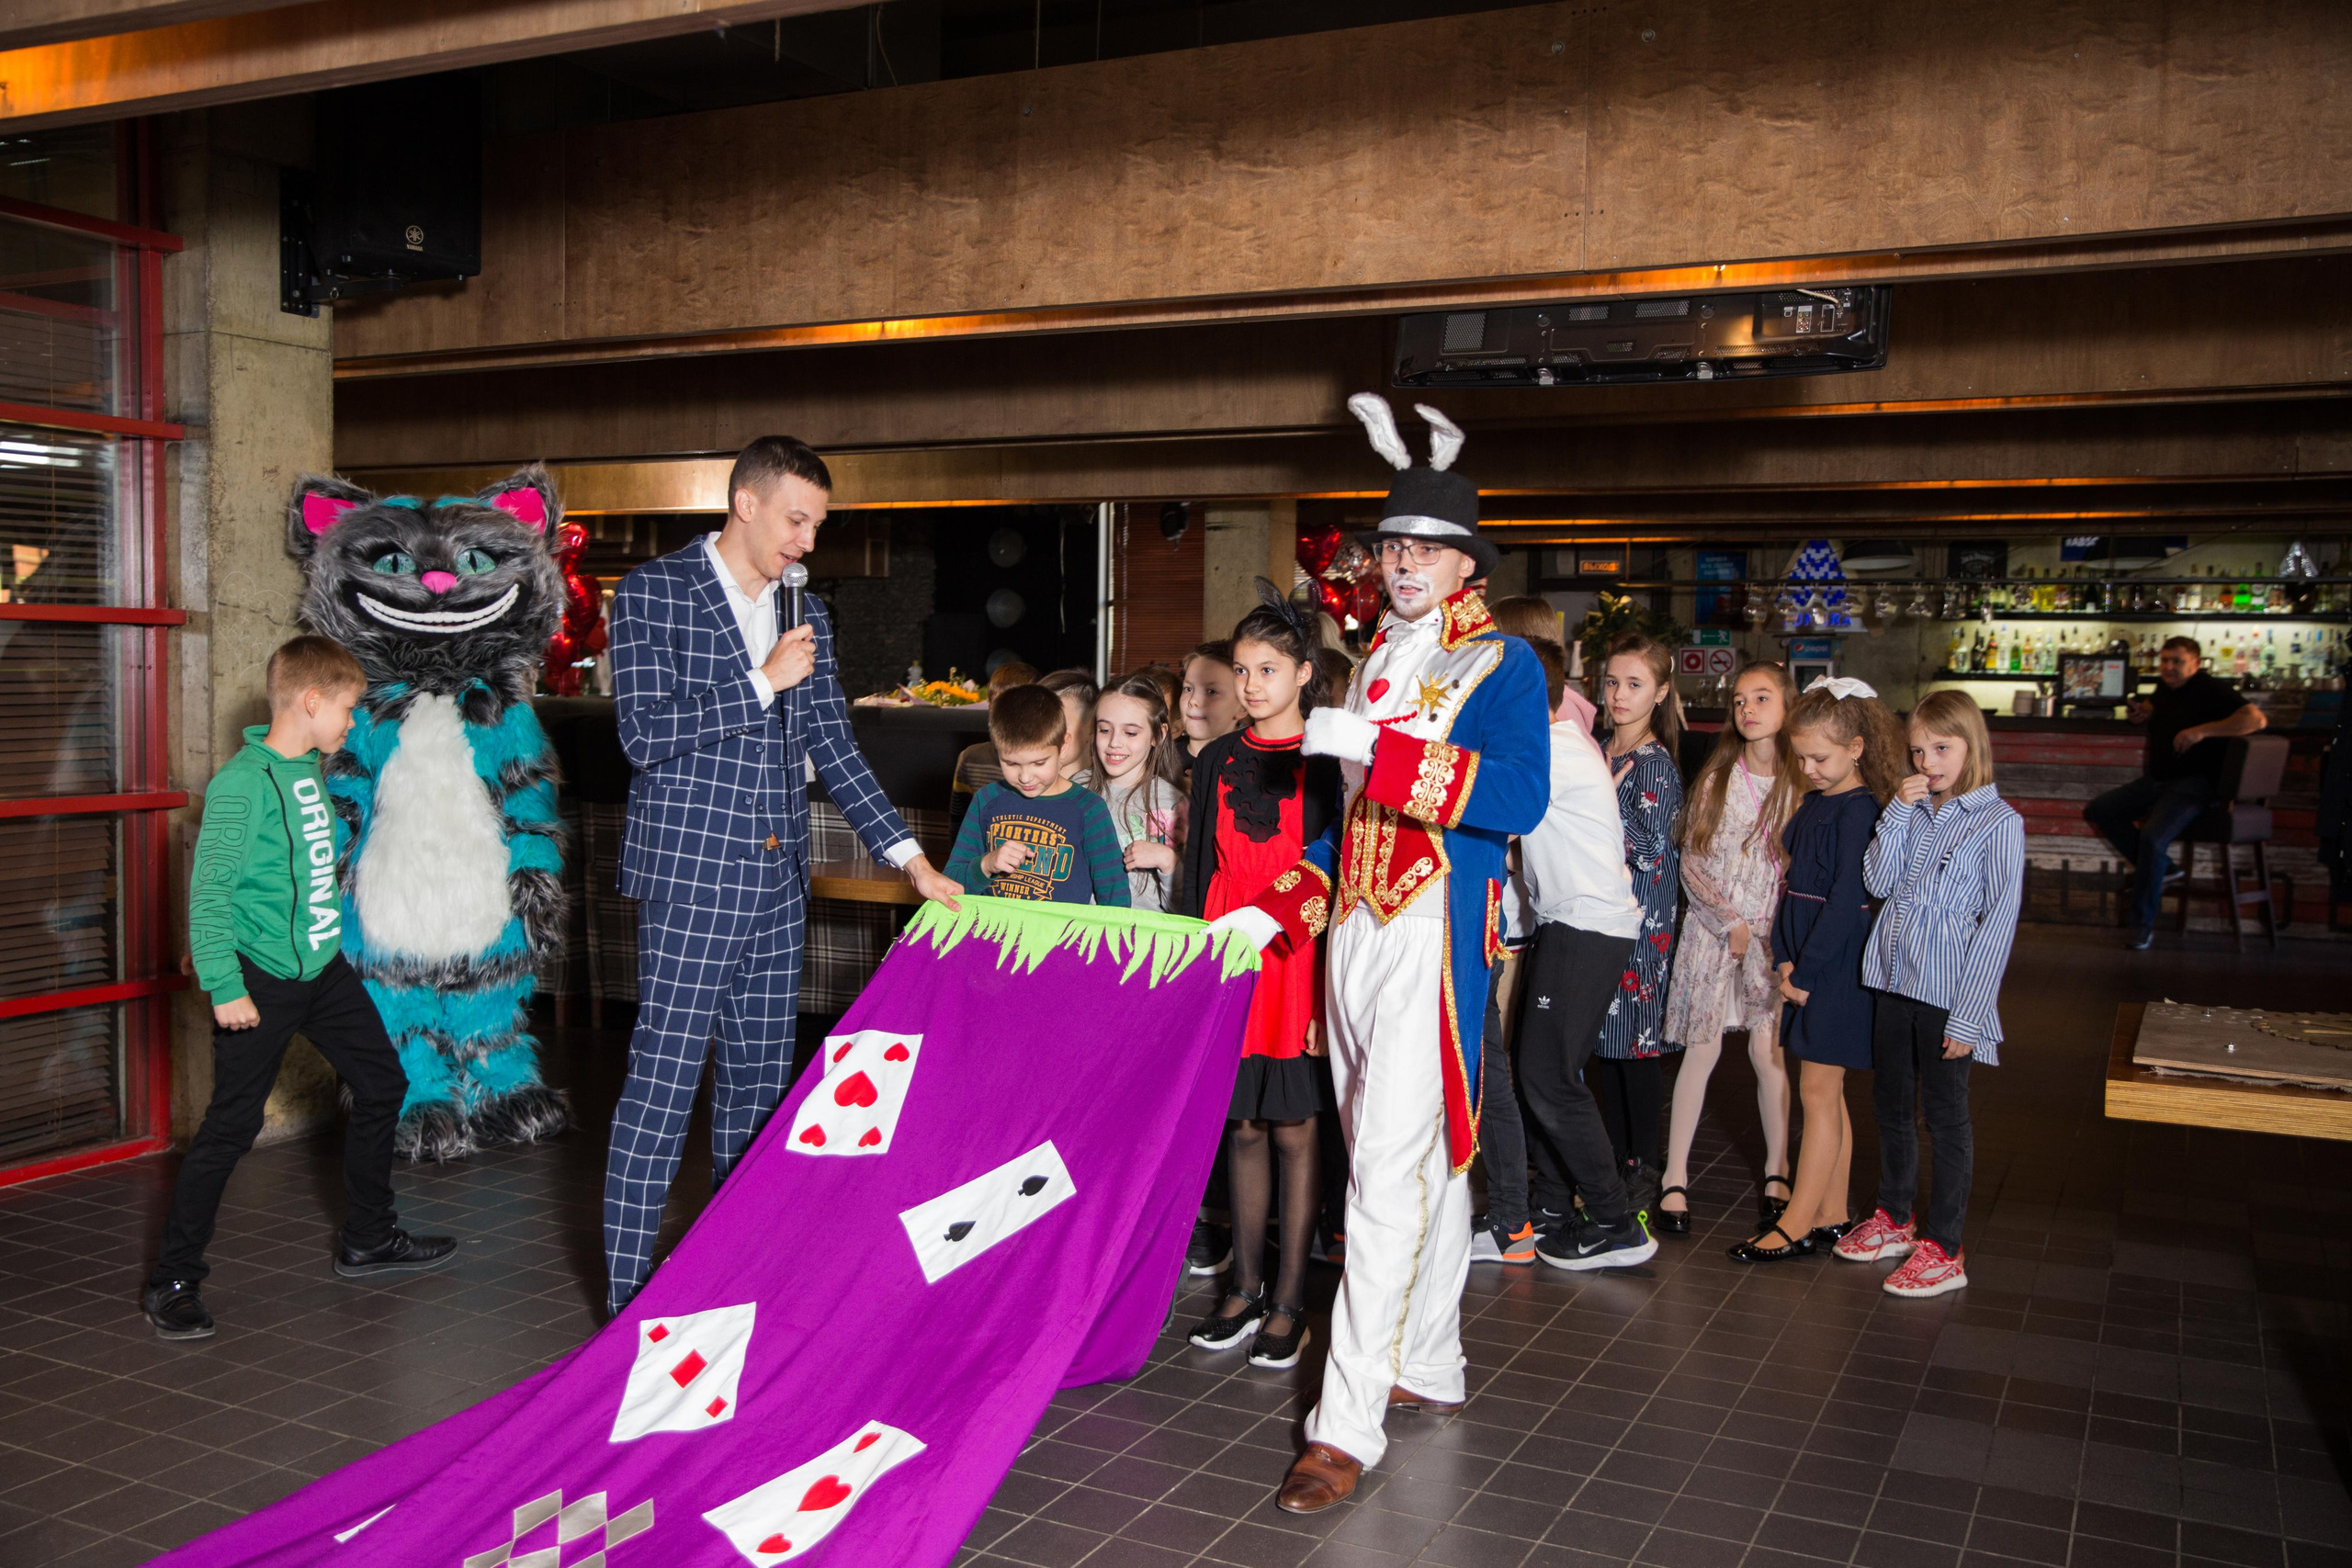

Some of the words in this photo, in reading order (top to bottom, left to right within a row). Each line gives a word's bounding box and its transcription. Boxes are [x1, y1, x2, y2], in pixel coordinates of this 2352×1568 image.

[992, 814, 1023, 823] ATHLETIC
[1026, 815, 1068, 834] DEPARTMENT
[992, 823, 1058, 846] FIGHTERS
[292, 777, 341, 952] ORIGINAL
[189, 795, 252, 964] ORIGINAL
[1000, 882, 1030, 896] WINNER
[1023, 876, 1046, 889] LEAGUE
